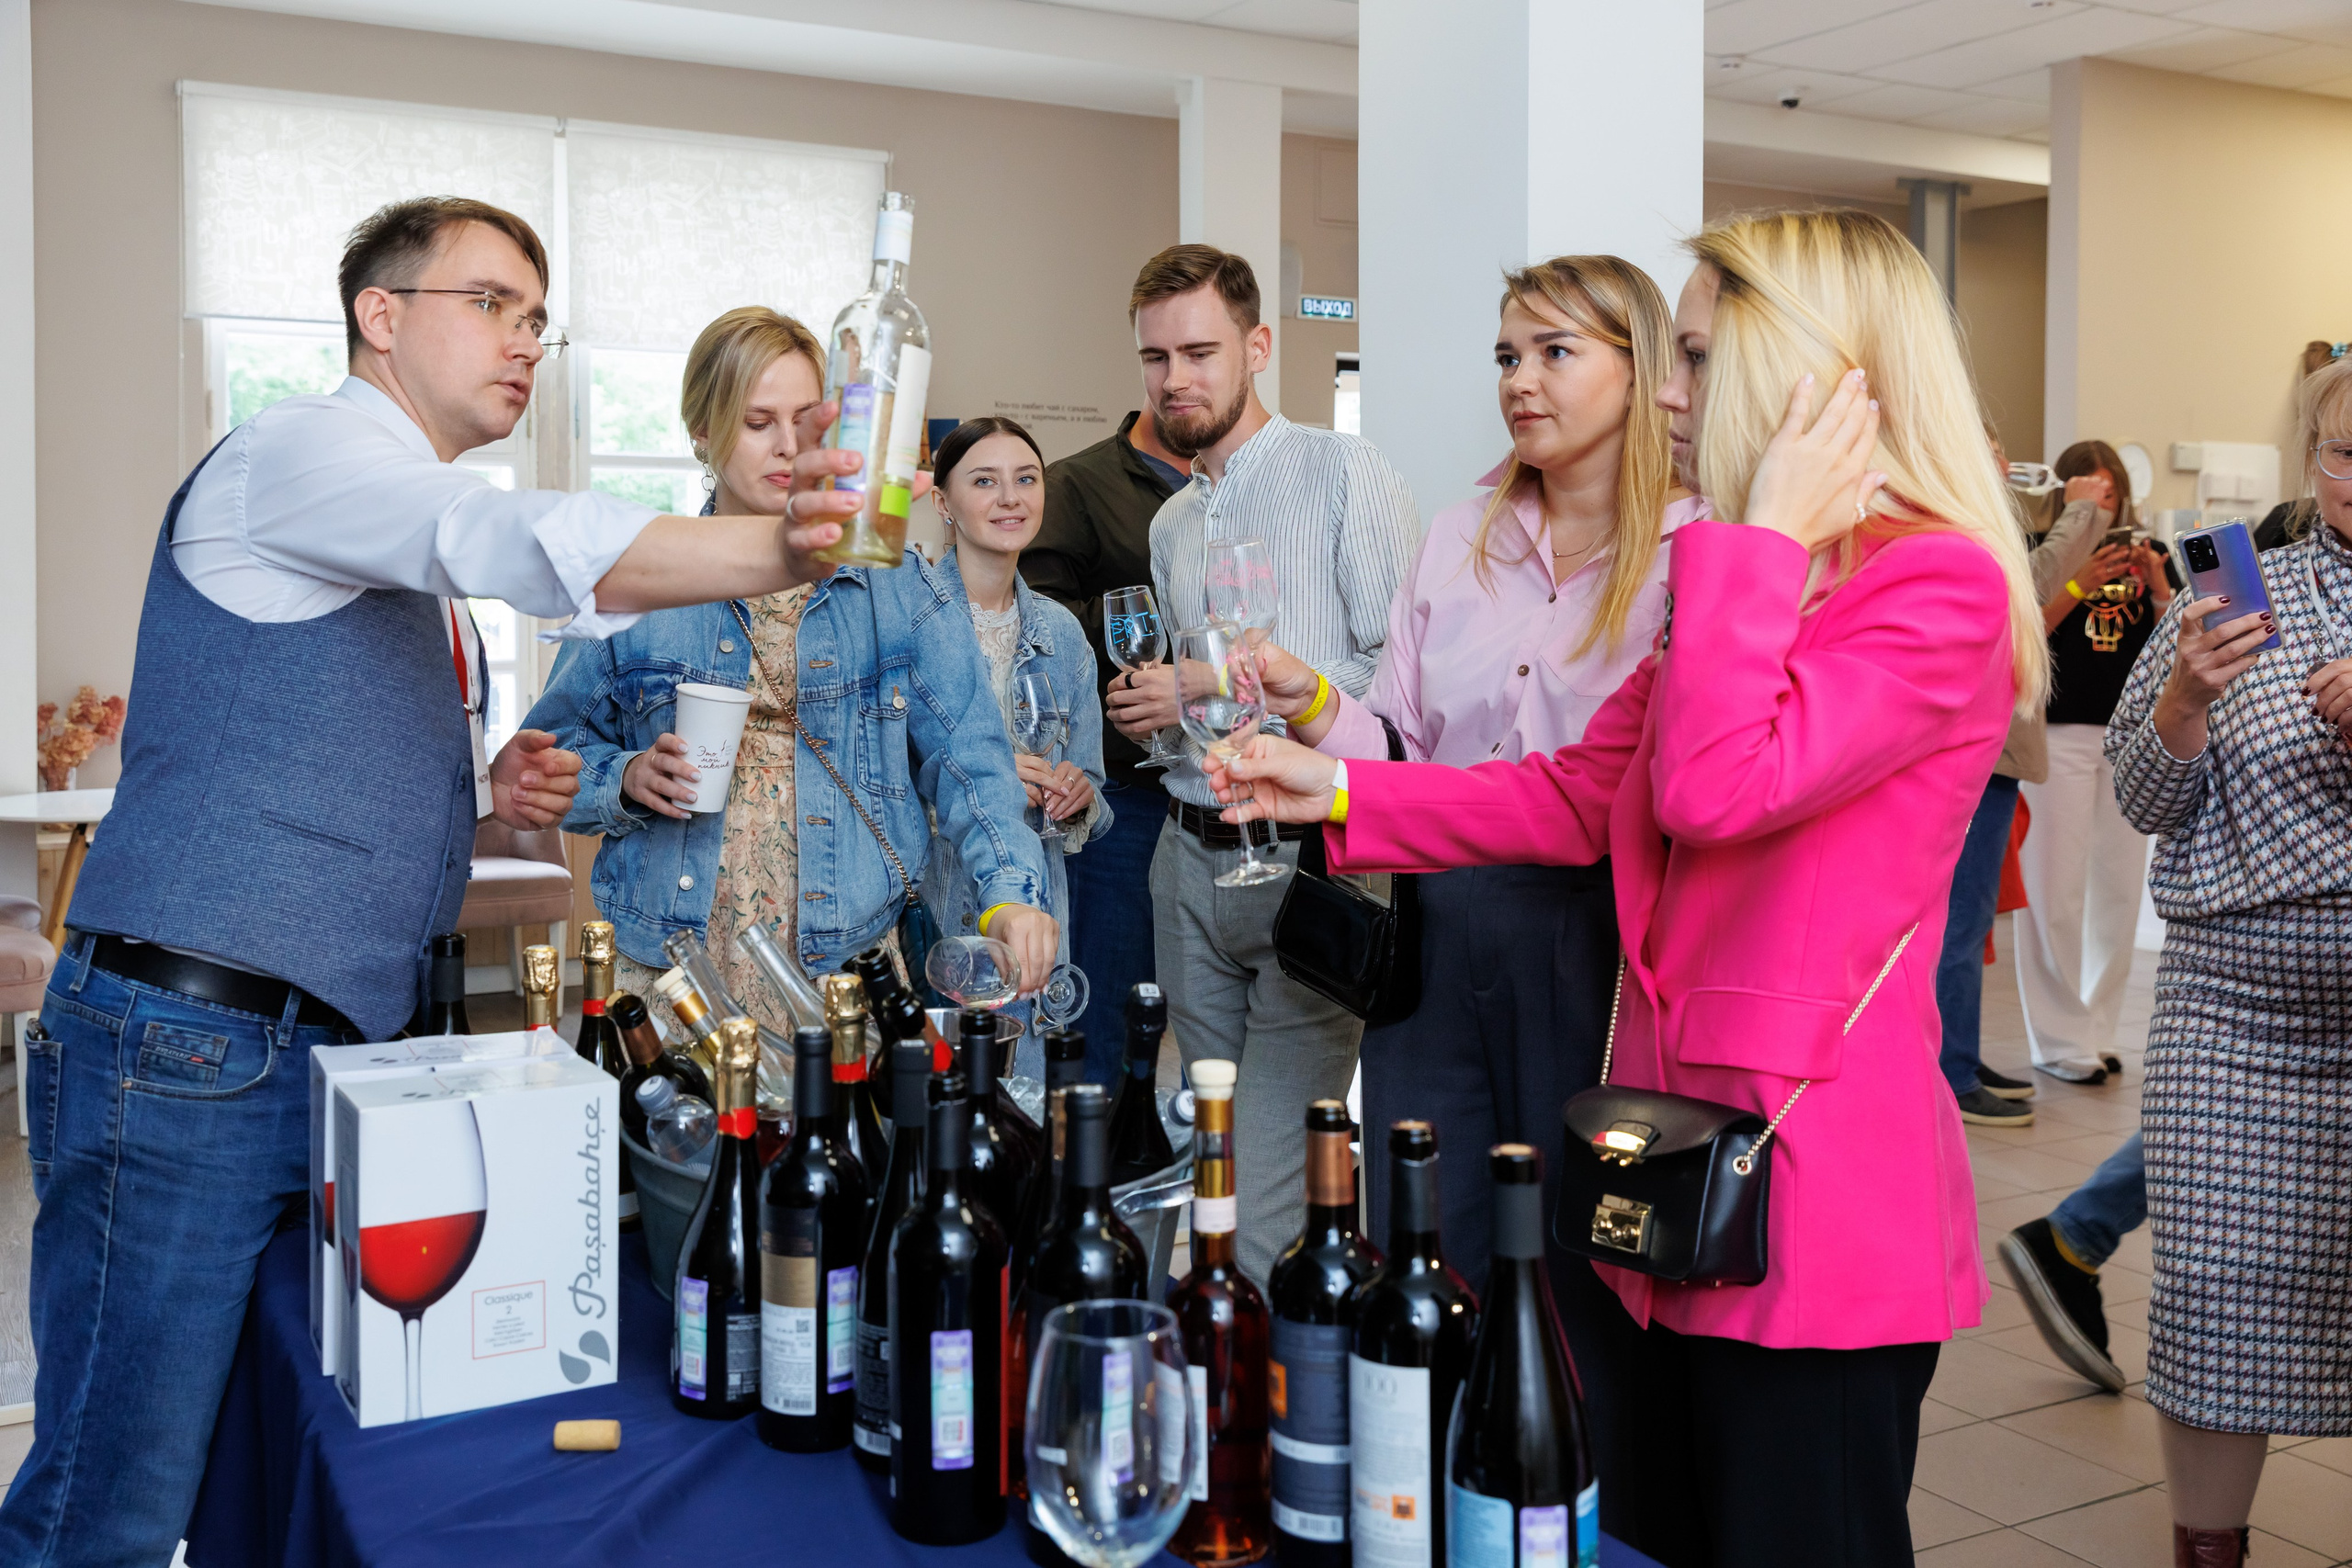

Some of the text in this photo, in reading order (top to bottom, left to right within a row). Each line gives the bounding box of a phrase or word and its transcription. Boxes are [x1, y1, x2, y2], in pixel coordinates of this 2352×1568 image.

[1303, 299, 1352, 317] ВЫХОД
[697, 745, 718, 757] Это
[697, 761, 729, 769] пикник
[484, 1291, 533, 1306] Classique
[505, 1304, 512, 1314] 2
